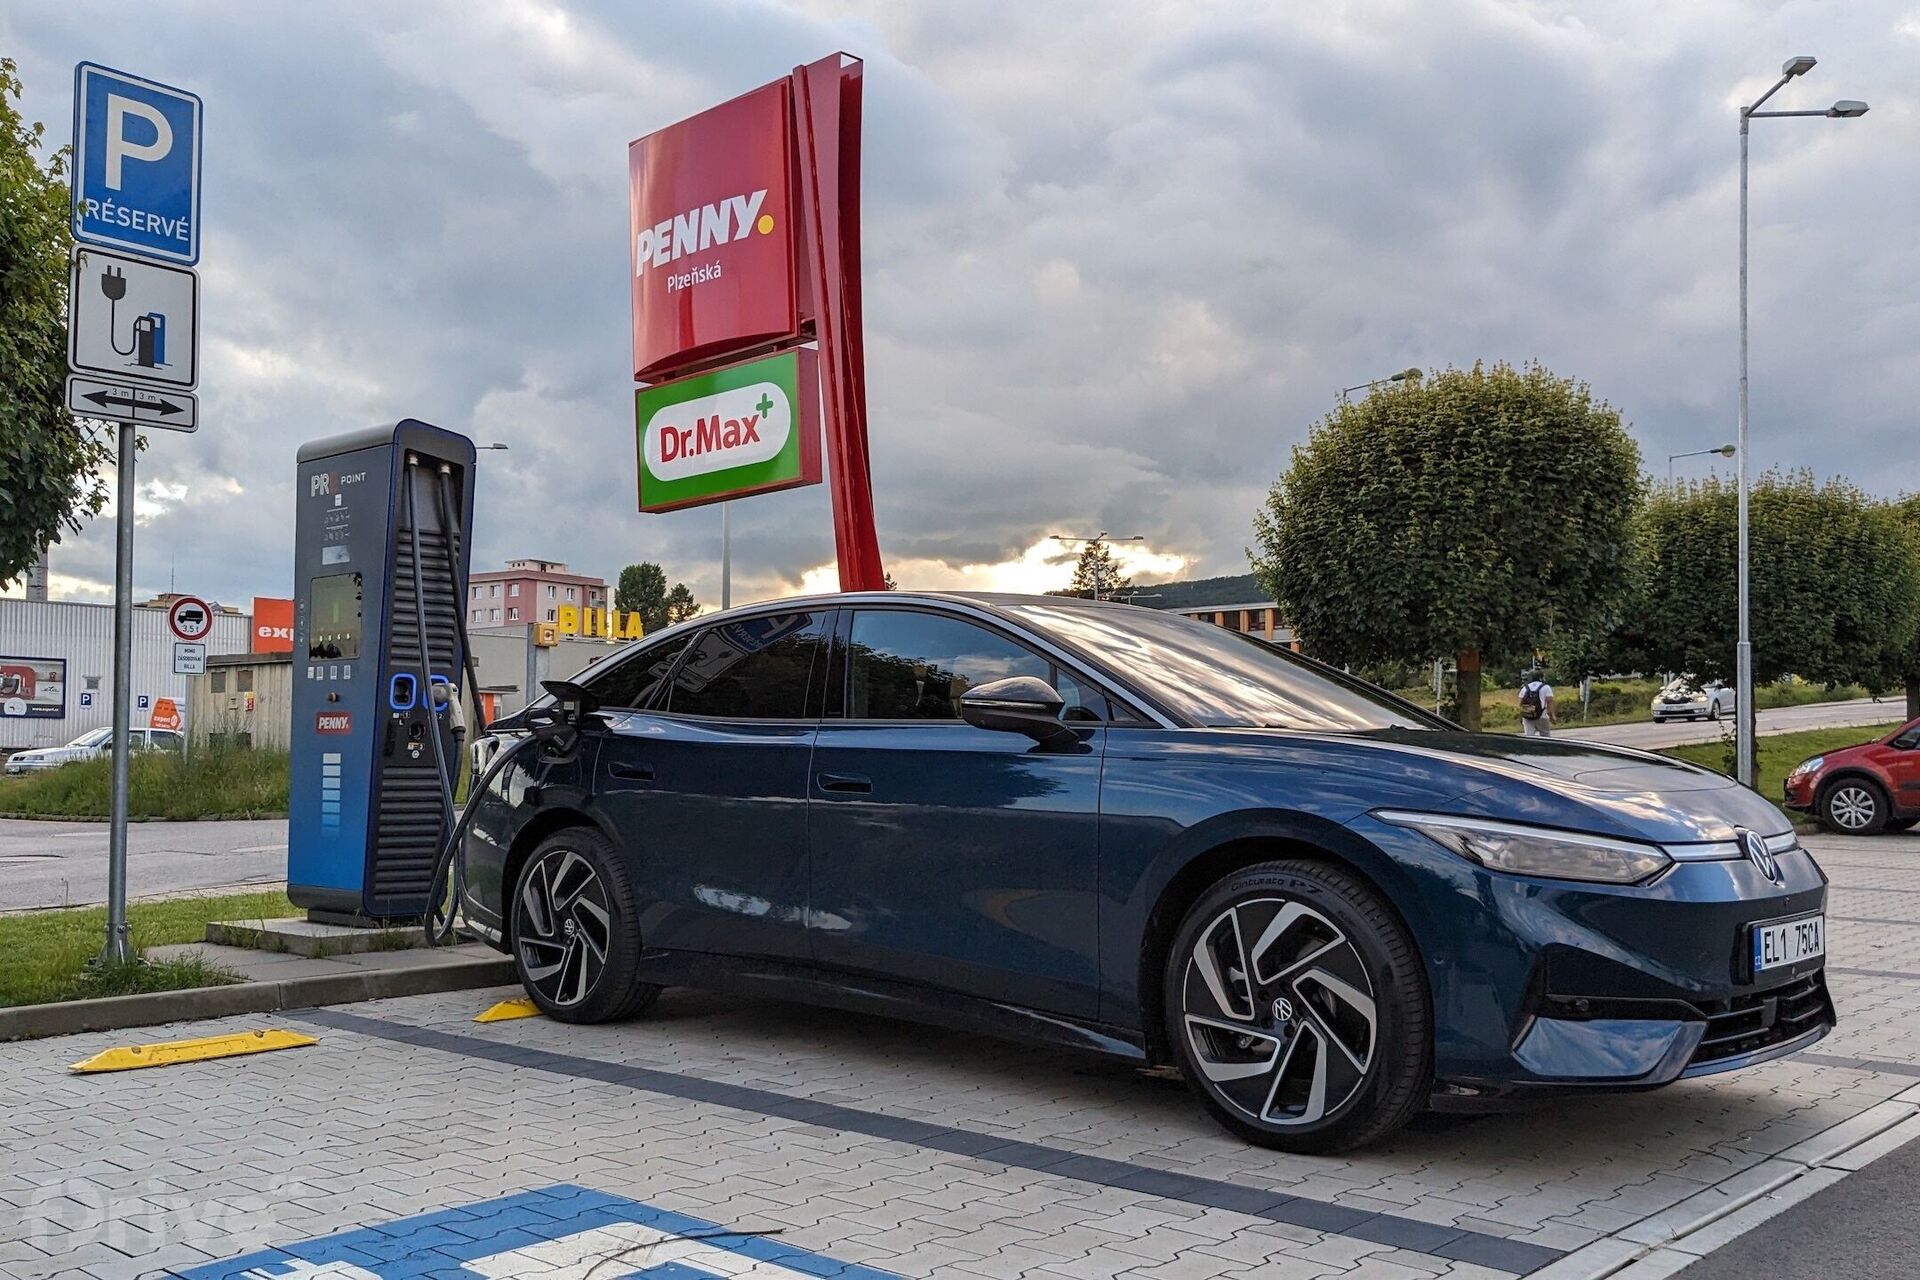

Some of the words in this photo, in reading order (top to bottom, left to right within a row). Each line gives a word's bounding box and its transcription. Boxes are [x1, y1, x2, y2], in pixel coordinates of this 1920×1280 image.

[105, 93, 173, 191] P
[85, 198, 189, 241] RÉSERVÉ
[667, 260, 722, 293] Plzeňská
[112, 388, 118, 396] 3
[340, 472, 366, 485] POINT
[558, 604, 645, 640] BILLA
[83, 694, 90, 704] P
[139, 697, 147, 707] P
[1231, 878, 1285, 891] Cinturato
[1289, 880, 1323, 894] P7
[1764, 928, 1787, 964] EL1
[1795, 921, 1820, 957] 75CA
